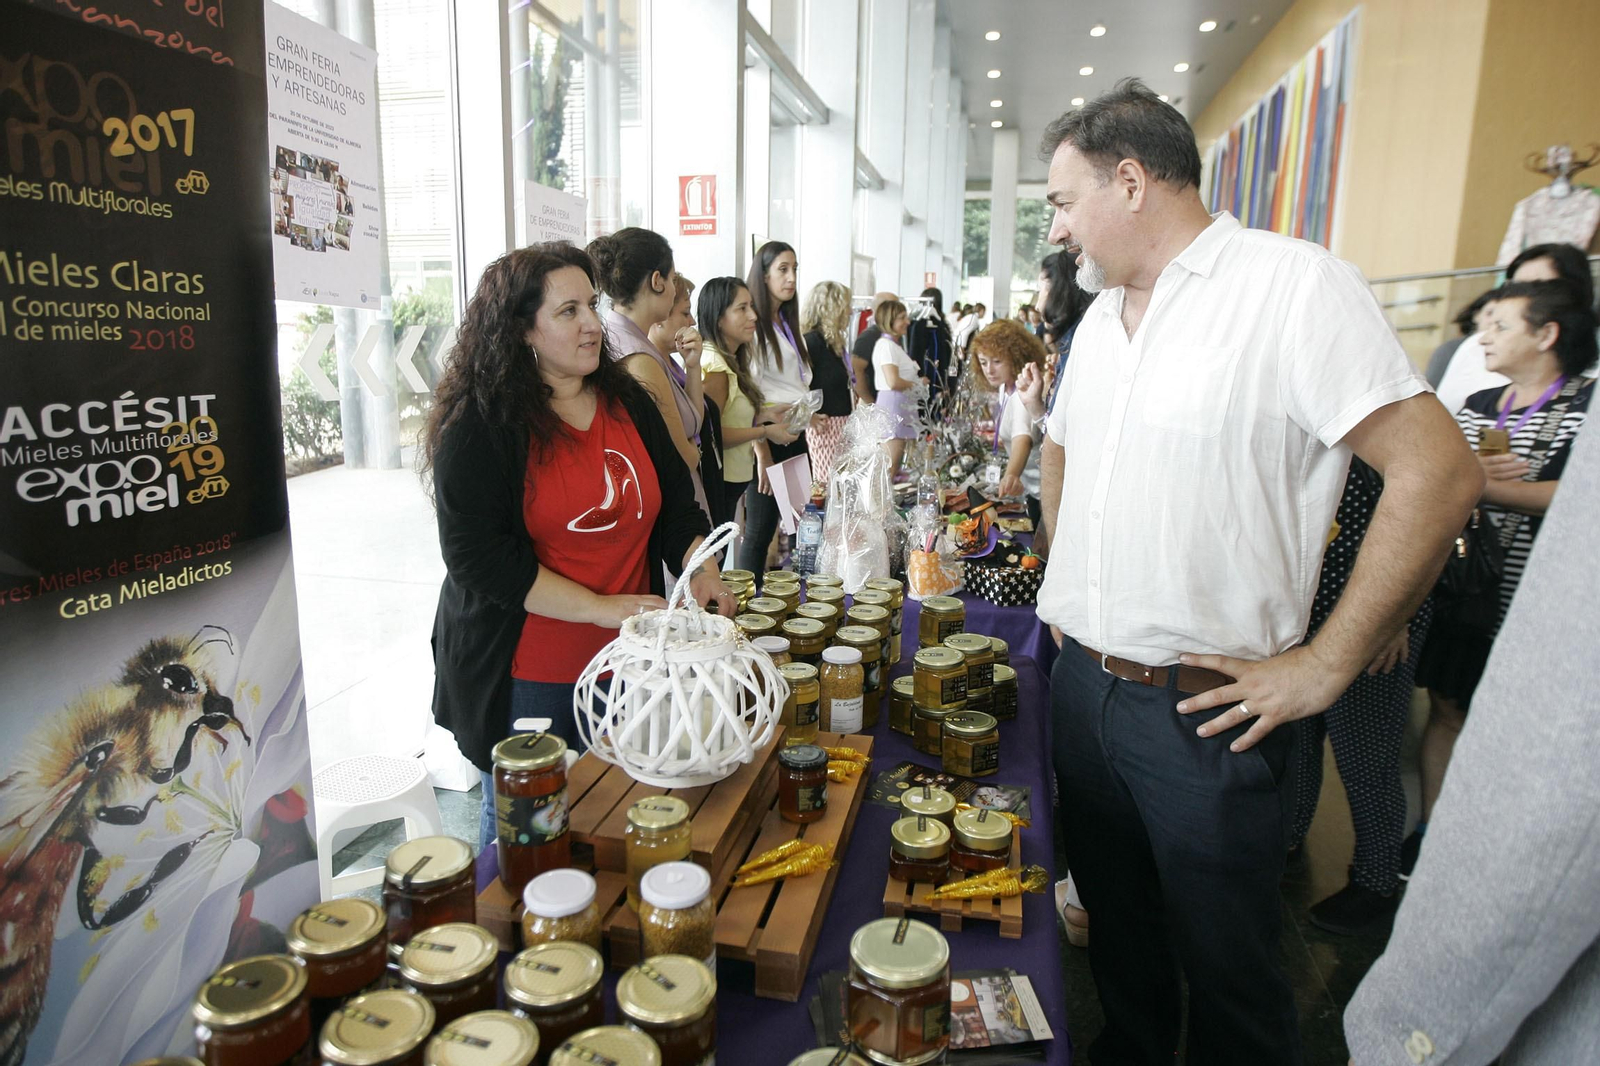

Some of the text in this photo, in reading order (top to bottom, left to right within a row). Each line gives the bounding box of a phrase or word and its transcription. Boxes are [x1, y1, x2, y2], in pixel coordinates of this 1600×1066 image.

[276, 35, 308, 62] GRAN
[312, 52, 341, 77] FERIA
[268, 52, 366, 106] EMPRENDEDORAS
[272, 74, 347, 116] Y ARTESANAS
[102, 108, 195, 157] 2017
[530, 214, 580, 236] DE EMPRENDEDORAS
[541, 204, 557, 217] GRAN
[683, 223, 713, 231] EXTINTOR
[110, 260, 205, 295] Claras
[12, 296, 211, 321] Concurso Nacional
[14, 319, 196, 350] de mieles 2018
[0, 390, 216, 444] ACCÉSIT
[1537, 402, 1572, 442] BIMBA
[1, 428, 219, 467] Mieles Multiflorales
[16, 454, 163, 503] expo
[65, 473, 180, 527] miel
[38, 565, 102, 597] Mieles
[106, 558, 130, 578] de
[134, 544, 193, 572] España
[59, 560, 233, 619] Cata Mieladictos
